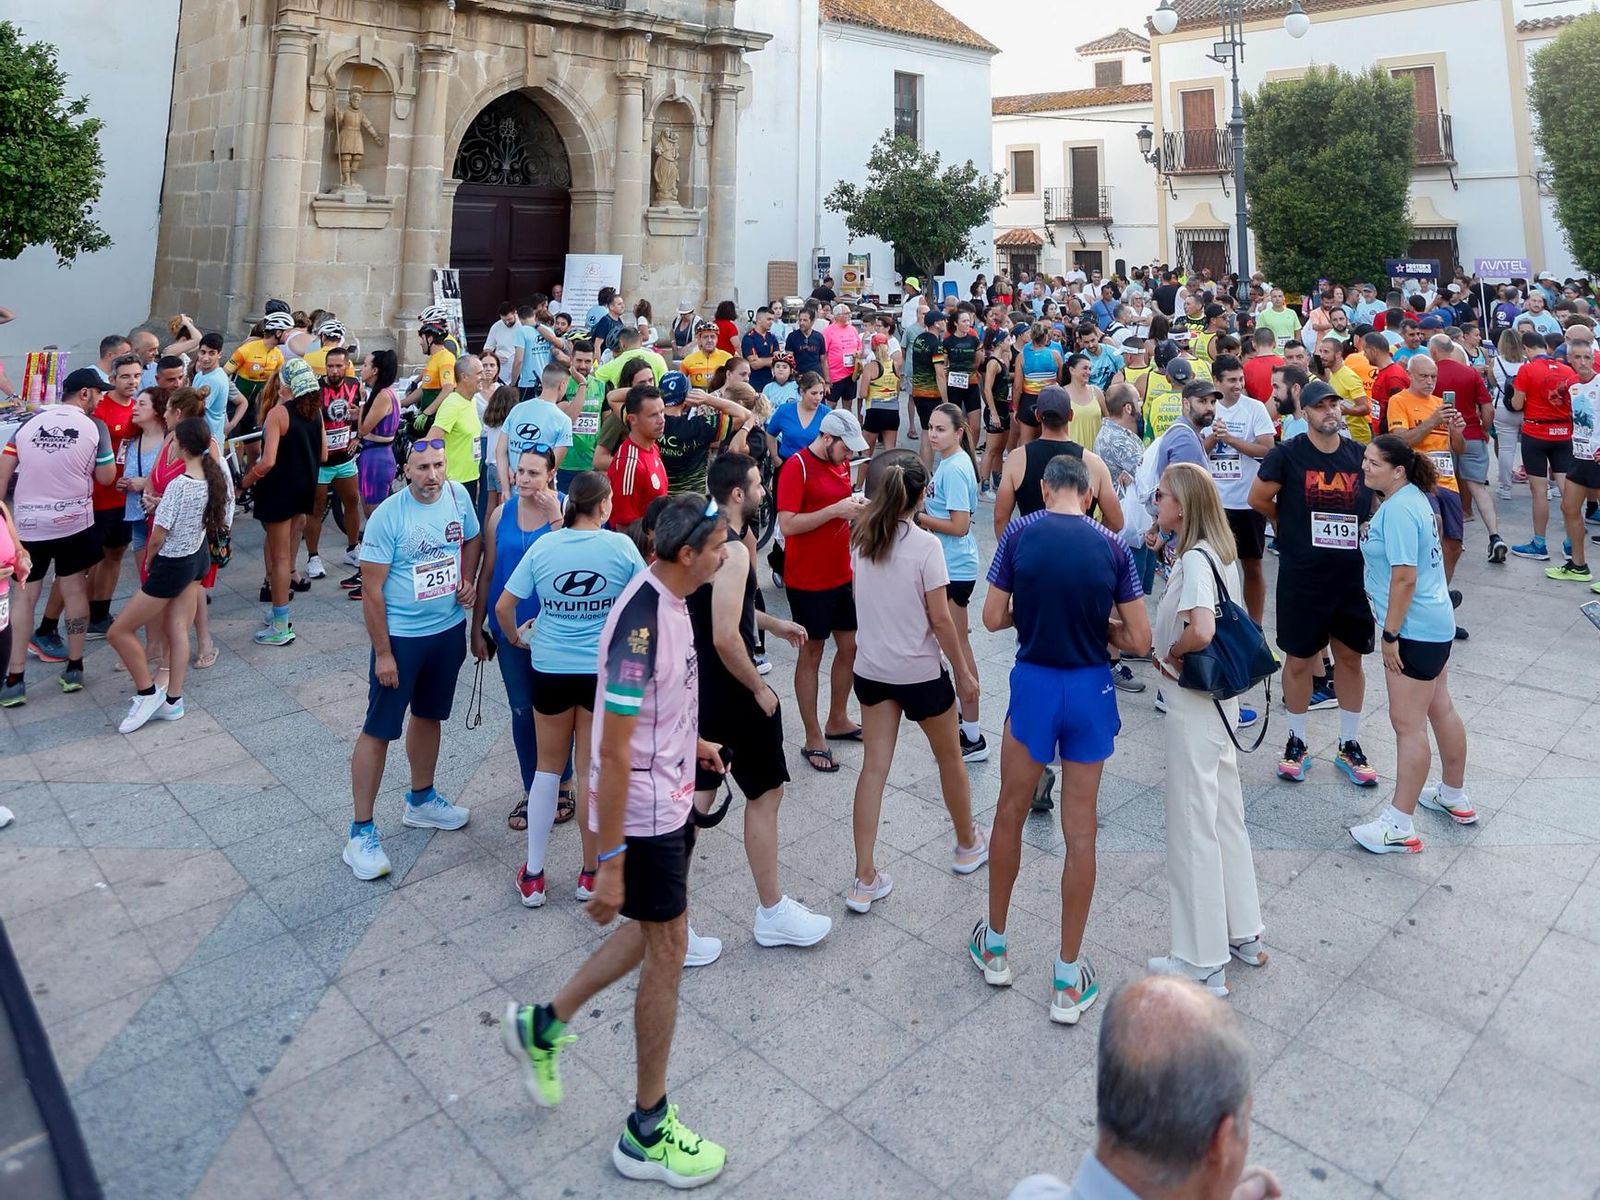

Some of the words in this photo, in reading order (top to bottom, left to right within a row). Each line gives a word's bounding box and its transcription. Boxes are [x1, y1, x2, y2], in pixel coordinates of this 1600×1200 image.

[1480, 260, 1527, 271] AVATEL
[578, 419, 594, 428] 253
[332, 434, 346, 443] 277
[1215, 461, 1233, 471] 161
[1305, 470, 1359, 493] PLAY
[1323, 523, 1349, 537] 419
[426, 569, 451, 588] 251
